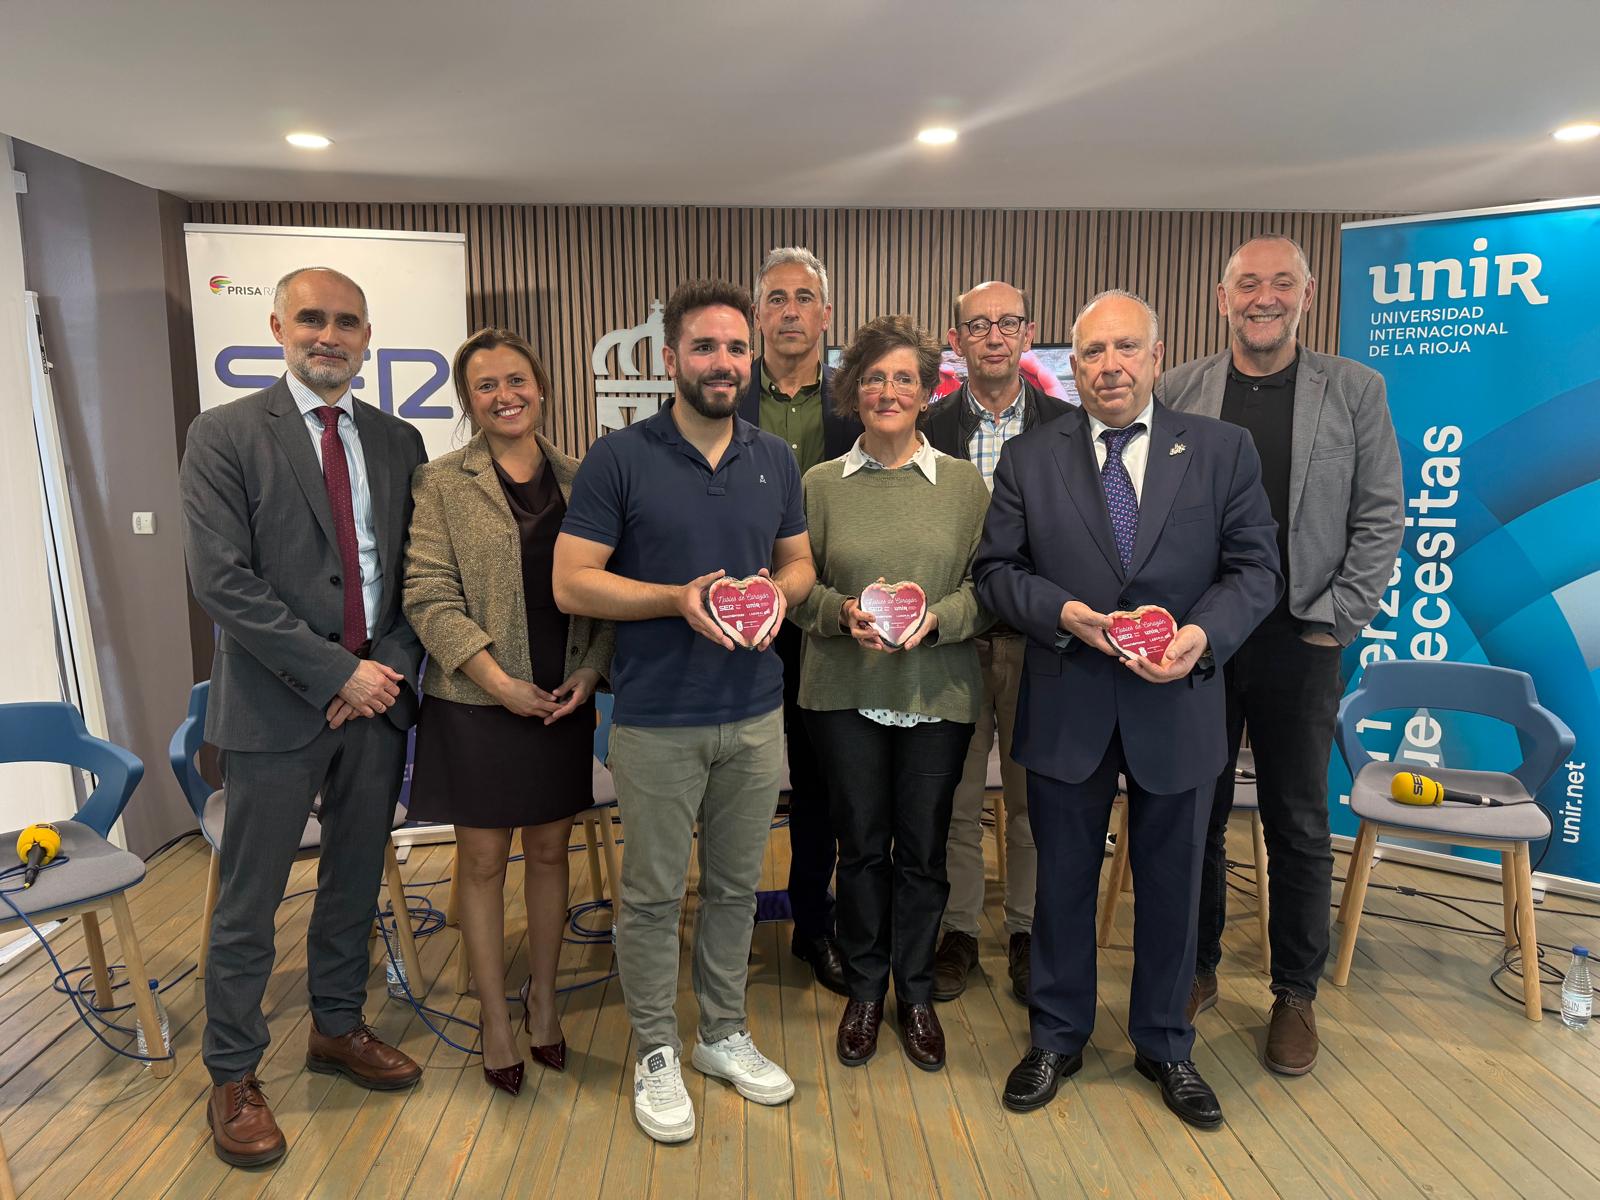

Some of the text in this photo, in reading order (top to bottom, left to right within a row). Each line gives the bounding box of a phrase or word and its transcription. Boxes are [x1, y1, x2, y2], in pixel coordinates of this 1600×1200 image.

[227, 286, 262, 296] PRISA
[1371, 306, 1484, 325] UNIVERSIDAD
[1369, 322, 1508, 341] INTERNACIONAL
[1369, 341, 1471, 357] DE LA RIOJA
[214, 345, 454, 419] SR
[1405, 425, 1463, 662] ecesitas
[1559, 760, 1586, 844] unir.net
